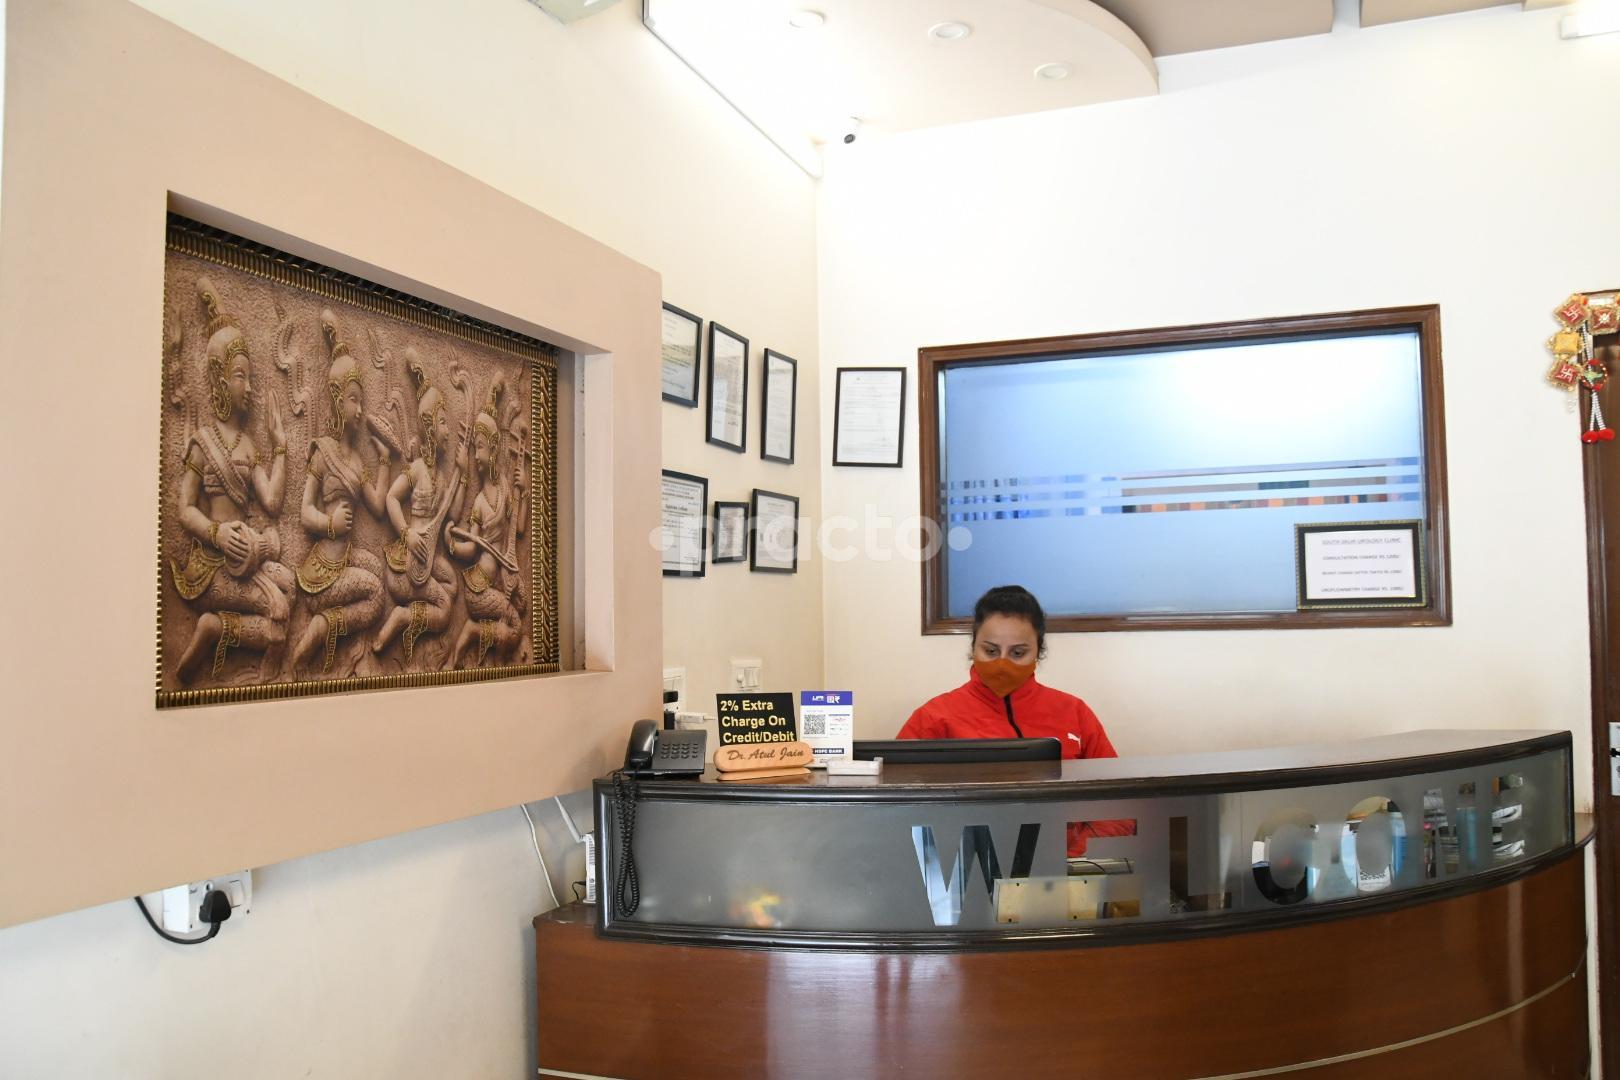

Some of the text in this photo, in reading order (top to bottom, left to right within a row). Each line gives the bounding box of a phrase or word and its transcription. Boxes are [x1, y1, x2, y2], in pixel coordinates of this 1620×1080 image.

[720, 700, 773, 711] 2% Extra
[722, 715, 786, 729] Charge On
[723, 731, 795, 743] Credit/Debit
[747, 748, 776, 760] Atul
[779, 746, 804, 761] Jain
[911, 774, 1526, 927] WELCOME
